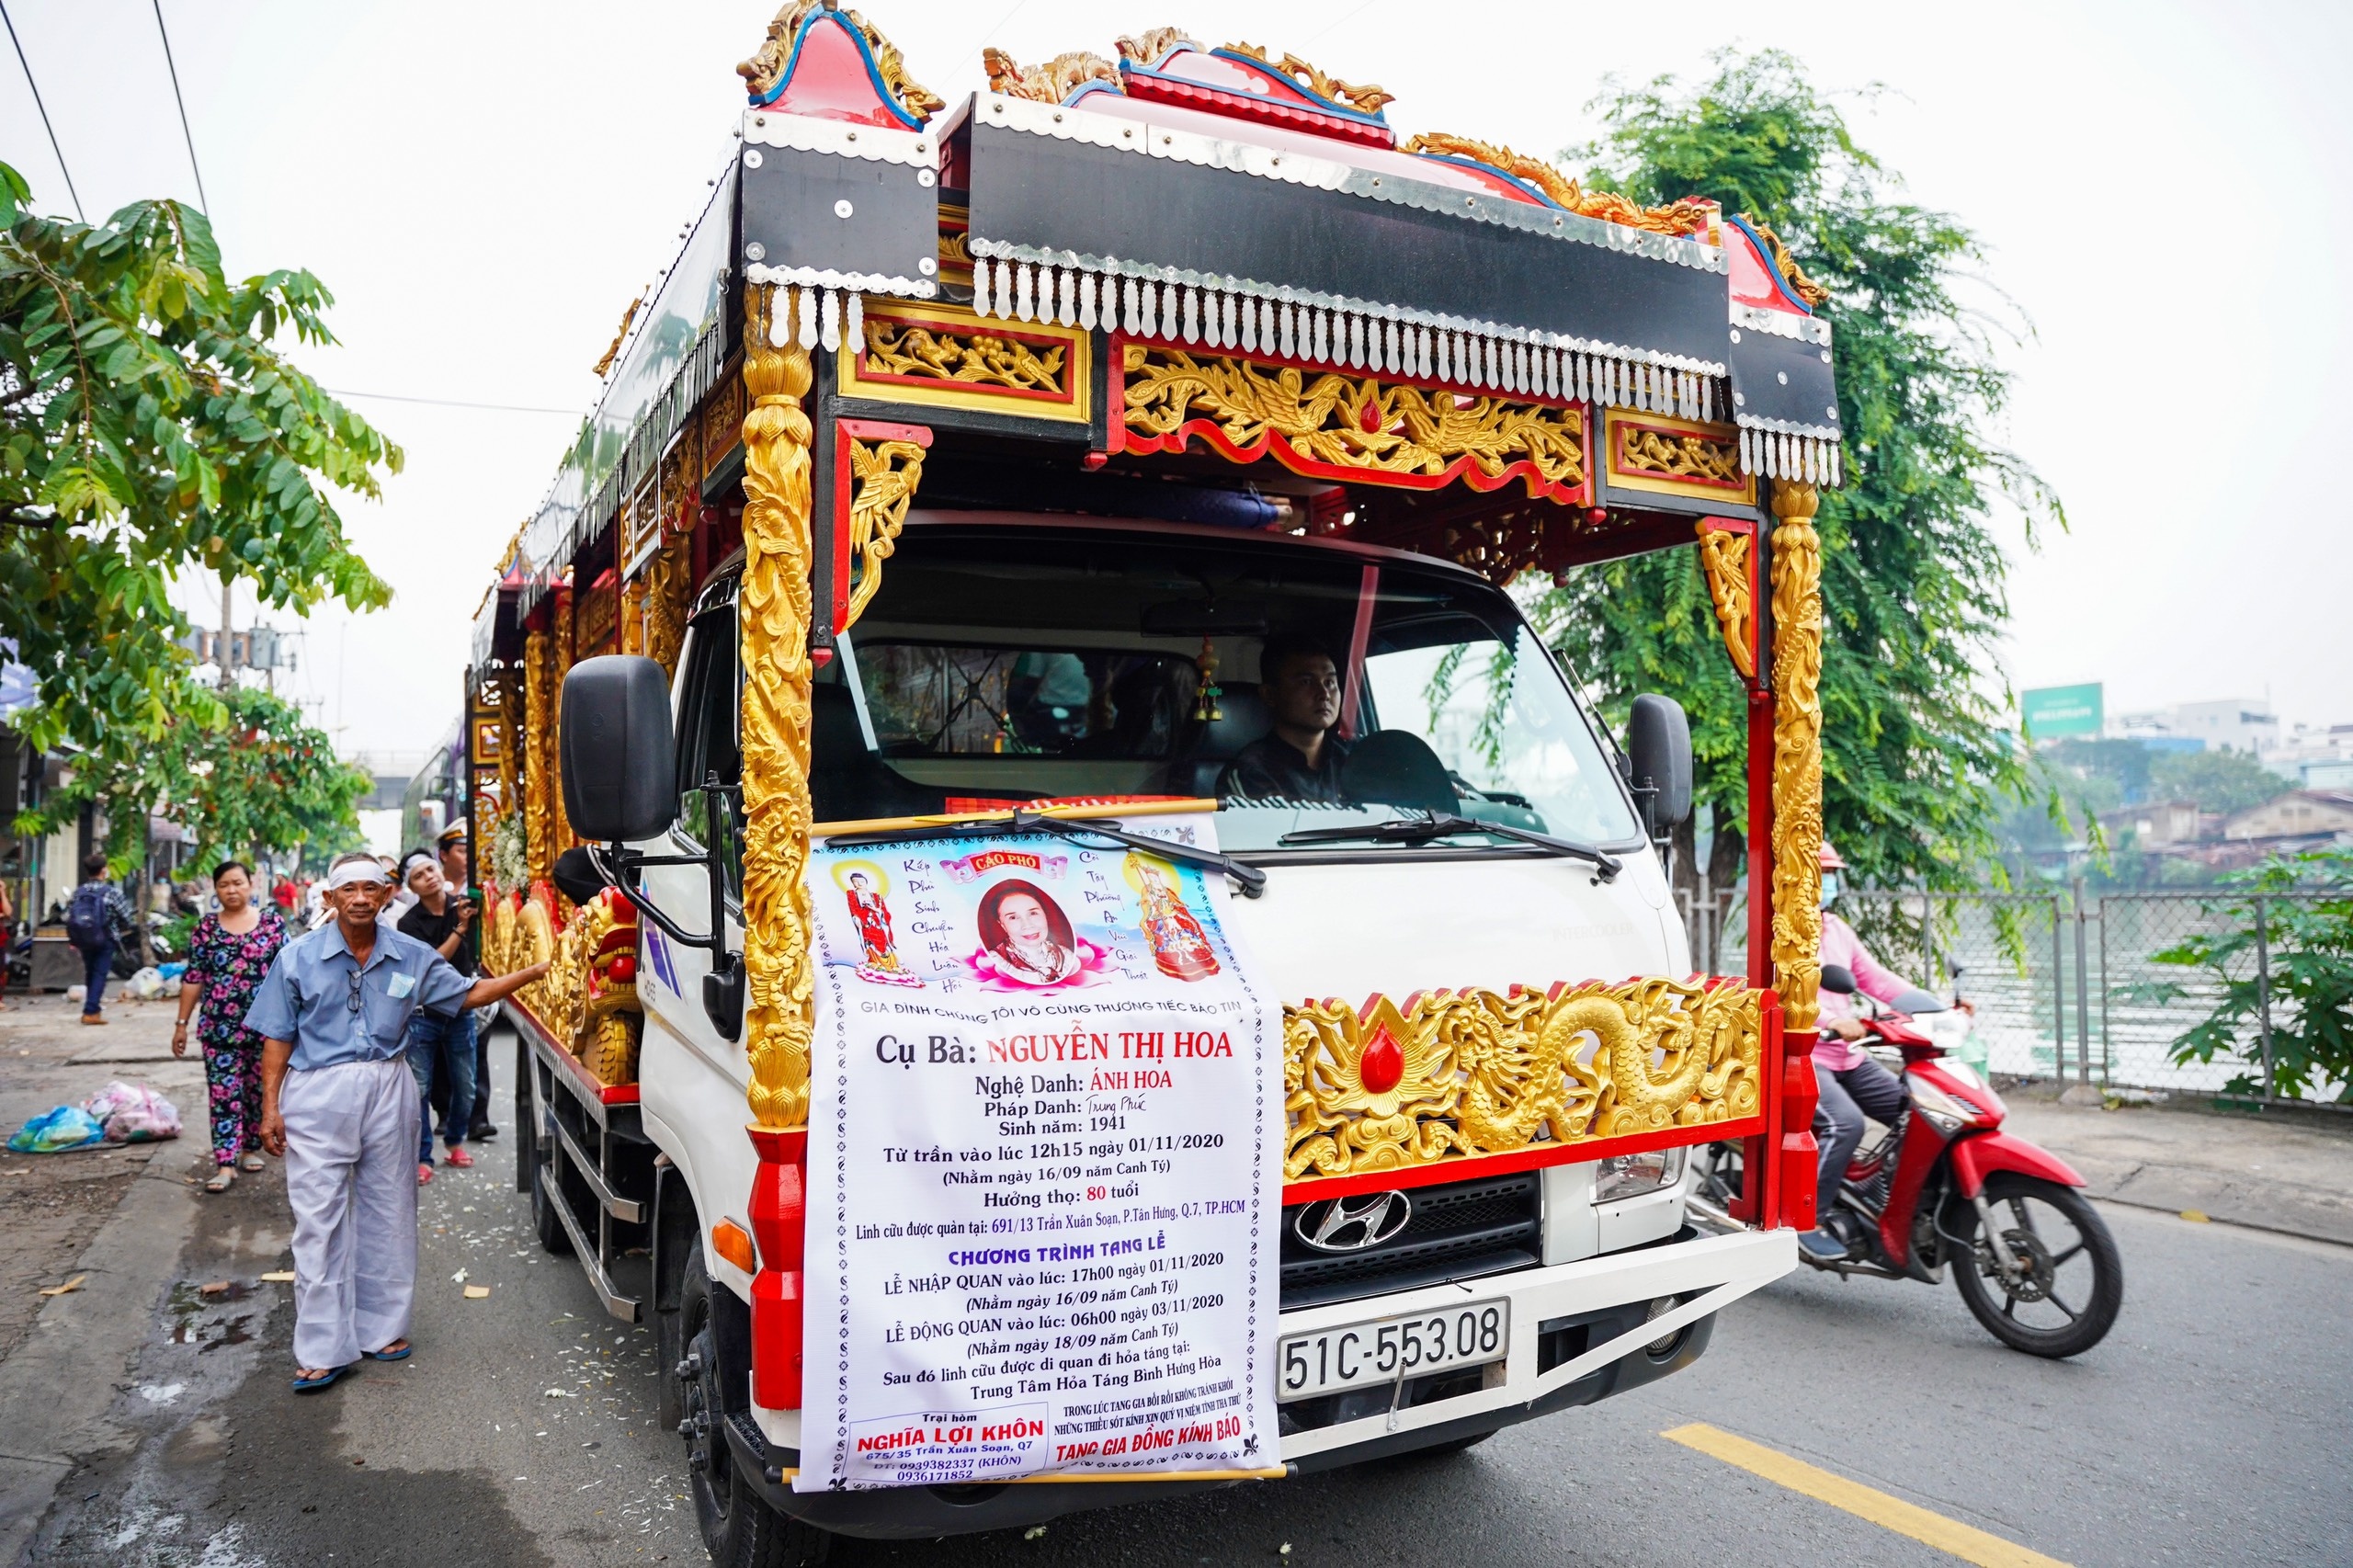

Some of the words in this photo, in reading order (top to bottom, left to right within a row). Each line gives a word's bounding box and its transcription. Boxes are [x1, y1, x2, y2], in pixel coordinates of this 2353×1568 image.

[904, 859, 930, 876] Kiếp
[975, 853, 1005, 870] CÁO
[1007, 854, 1037, 869] PHÓ
[1086, 871, 1108, 891] Tây
[915, 901, 940, 914] Sinh
[1104, 911, 1119, 923] An
[929, 941, 949, 952] Hóa
[861, 1001, 890, 1013] GIA
[894, 1002, 930, 1015] ĐÌNH
[935, 1008, 988, 1024] CHÚNG
[991, 1006, 1015, 1020] TÔI
[1018, 1006, 1040, 1016] VÔ
[1045, 1005, 1091, 1014] CÙNG
[1094, 1001, 1154, 1012] THƯƠNG
[1156, 1000, 1188, 1011] TIẾC
[1190, 1003, 1217, 1014] BÁO
[1220, 1001, 1242, 1012] TIN
[876, 1035, 915, 1070] Cụ
[928, 1036, 975, 1063] Bà:
[986, 1019, 1108, 1063] NGUYỄN
[1119, 1032, 1165, 1063] THỊ
[1174, 1031, 1233, 1057] HOA
[975, 1076, 1024, 1098] Nghệ
[1031, 1074, 1084, 1094] Danh:
[1090, 1067, 1129, 1090] ÁNH
[1134, 1071, 1173, 1088] HOA
[984, 1102, 1029, 1119] Pháp
[1035, 1099, 1082, 1115] Danh:
[1086, 1094, 1116, 1117] Trung
[1120, 1093, 1147, 1111] Phúc
[999, 1120, 1036, 1136] Sinh
[1041, 1120, 1083, 1134] năm:
[1090, 1115, 1126, 1131] 1941
[883, 1148, 907, 1162] Từ
[914, 1145, 953, 1162] trần
[960, 1149, 992, 1162] vào
[998, 1146, 1023, 1161] lúc
[1030, 1142, 1083, 1158] 12h15
[1088, 1141, 1124, 1158] ngày
[1129, 1134, 1223, 1153] 01/11/2020
[943, 1169, 993, 1186] (Nhằm
[998, 1171, 1032, 1186] ngày
[1038, 1166, 1081, 1181] 16/09
[1086, 1166, 1112, 1177] năm
[1117, 1161, 1147, 1175] Canh
[1151, 1159, 1171, 1174] Tý)
[984, 1191, 1041, 1208] Hưởng
[1047, 1189, 1080, 1205] thọ:
[1086, 1186, 1107, 1201] 80
[1111, 1179, 1139, 1198] tuổi
[856, 1223, 880, 1239] Linh
[883, 1223, 904, 1237] cữu
[907, 1221, 933, 1238] được
[937, 1220, 965, 1237] quàn
[969, 1220, 988, 1236] tại:
[992, 1217, 1034, 1234] 691/13
[1038, 1212, 1062, 1230] Trần
[1065, 1214, 1092, 1228] Xuân
[1096, 1211, 1120, 1228] Soạn,
[1123, 1207, 1150, 1223] P.Tân
[1153, 1205, 1178, 1221] Hưng,
[1181, 1202, 1201, 1218] Q.7,
[1205, 1199, 1245, 1215] TP.HCM
[949, 1249, 1030, 1267] CHƯƠNG
[1037, 1243, 1094, 1262] TRÌNH
[1100, 1239, 1142, 1257] TANG
[1148, 1230, 1165, 1250] LỄ
[884, 1273, 903, 1295] LỄ
[908, 1273, 951, 1293] NHẬP
[956, 1274, 1002, 1290] QUAN
[1008, 1272, 1034, 1286] vào
[1040, 1271, 1065, 1284] lúc:
[1072, 1266, 1114, 1282] 17h00
[1118, 1263, 1146, 1278] ngày
[1150, 1252, 1223, 1273] 01/11/2020
[966, 1294, 1012, 1313] (Nhằm
[1017, 1295, 1051, 1310] ngày
[1056, 1290, 1097, 1306] 16/09
[1101, 1290, 1127, 1301] năm
[1131, 1282, 1157, 1298] Canh
[1161, 1279, 1178, 1294] Tý)
[886, 1321, 904, 1343] LỄ
[911, 1321, 954, 1341] ĐỘNG
[958, 1318, 1002, 1335] QUAN
[1007, 1319, 1034, 1331] vào
[1039, 1315, 1065, 1328] lúc:
[1071, 1310, 1116, 1326] 06h00
[1120, 1307, 1148, 1324] ngày
[1152, 1294, 1223, 1316] 03/11/2020
[967, 1339, 1010, 1359] (Nhằm
[1015, 1339, 1049, 1354] ngày
[1054, 1334, 1097, 1350] 18/09
[1099, 1334, 1128, 1346] năm
[1131, 1326, 1158, 1342] Canh
[1162, 1322, 1178, 1337] Tý)
[1286, 1307, 1500, 1390] 51C-553.08
[883, 1372, 911, 1385] Sau
[916, 1370, 936, 1382] đó
[941, 1367, 966, 1381] linh
[972, 1364, 995, 1378] cữu
[1000, 1360, 1035, 1375] được
[1040, 1358, 1053, 1370] di
[1059, 1358, 1093, 1371] quan
[1097, 1353, 1111, 1366] đi
[1116, 1348, 1140, 1364] hỏa
[1143, 1346, 1169, 1360] táng
[1172, 1340, 1190, 1354] tại:
[971, 1385, 1013, 1400] Trung
[1017, 1380, 1051, 1393] Tâm
[1057, 1375, 1086, 1390] Hỏa
[1093, 1372, 1129, 1387] Táng
[1133, 1366, 1163, 1382] Bình
[1166, 1362, 1196, 1375] Hưng
[1199, 1355, 1222, 1369] Hòa
[923, 1414, 947, 1423] Trại
[951, 1413, 977, 1423] hòm
[1063, 1404, 1092, 1417] TRONG
[1093, 1400, 1108, 1415] LÚC
[1110, 1399, 1132, 1413] TANG
[1132, 1397, 1145, 1410] GIA
[858, 1427, 925, 1452] NGHĨA
[934, 1426, 973, 1446] LỢI
[981, 1417, 1044, 1441] KHÔN
[1054, 1421, 1083, 1436] NHỮNG
[1109, 1412, 1124, 1427] SÓT
[1125, 1411, 1144, 1426] KÍNH
[1144, 1411, 1159, 1423] XIN
[1160, 1407, 1175, 1422] QUÝ
[1176, 1408, 1184, 1419] VỊ
[866, 1449, 912, 1460] 675/35
[948, 1446, 977, 1454] Xuân
[981, 1444, 1014, 1454] Soạn,
[1017, 1440, 1033, 1450] Q7
[1056, 1441, 1098, 1462] TANG
[1102, 1436, 1127, 1456] GIA
[1131, 1422, 1174, 1452] ĐỒNG
[1177, 1420, 1212, 1446] KÍNH
[1217, 1411, 1241, 1441] BÁO
[897, 1470, 973, 1482] 0936171852
[899, 1459, 974, 1471] 0939382337
[978, 1456, 1022, 1469] (KHÔN)
